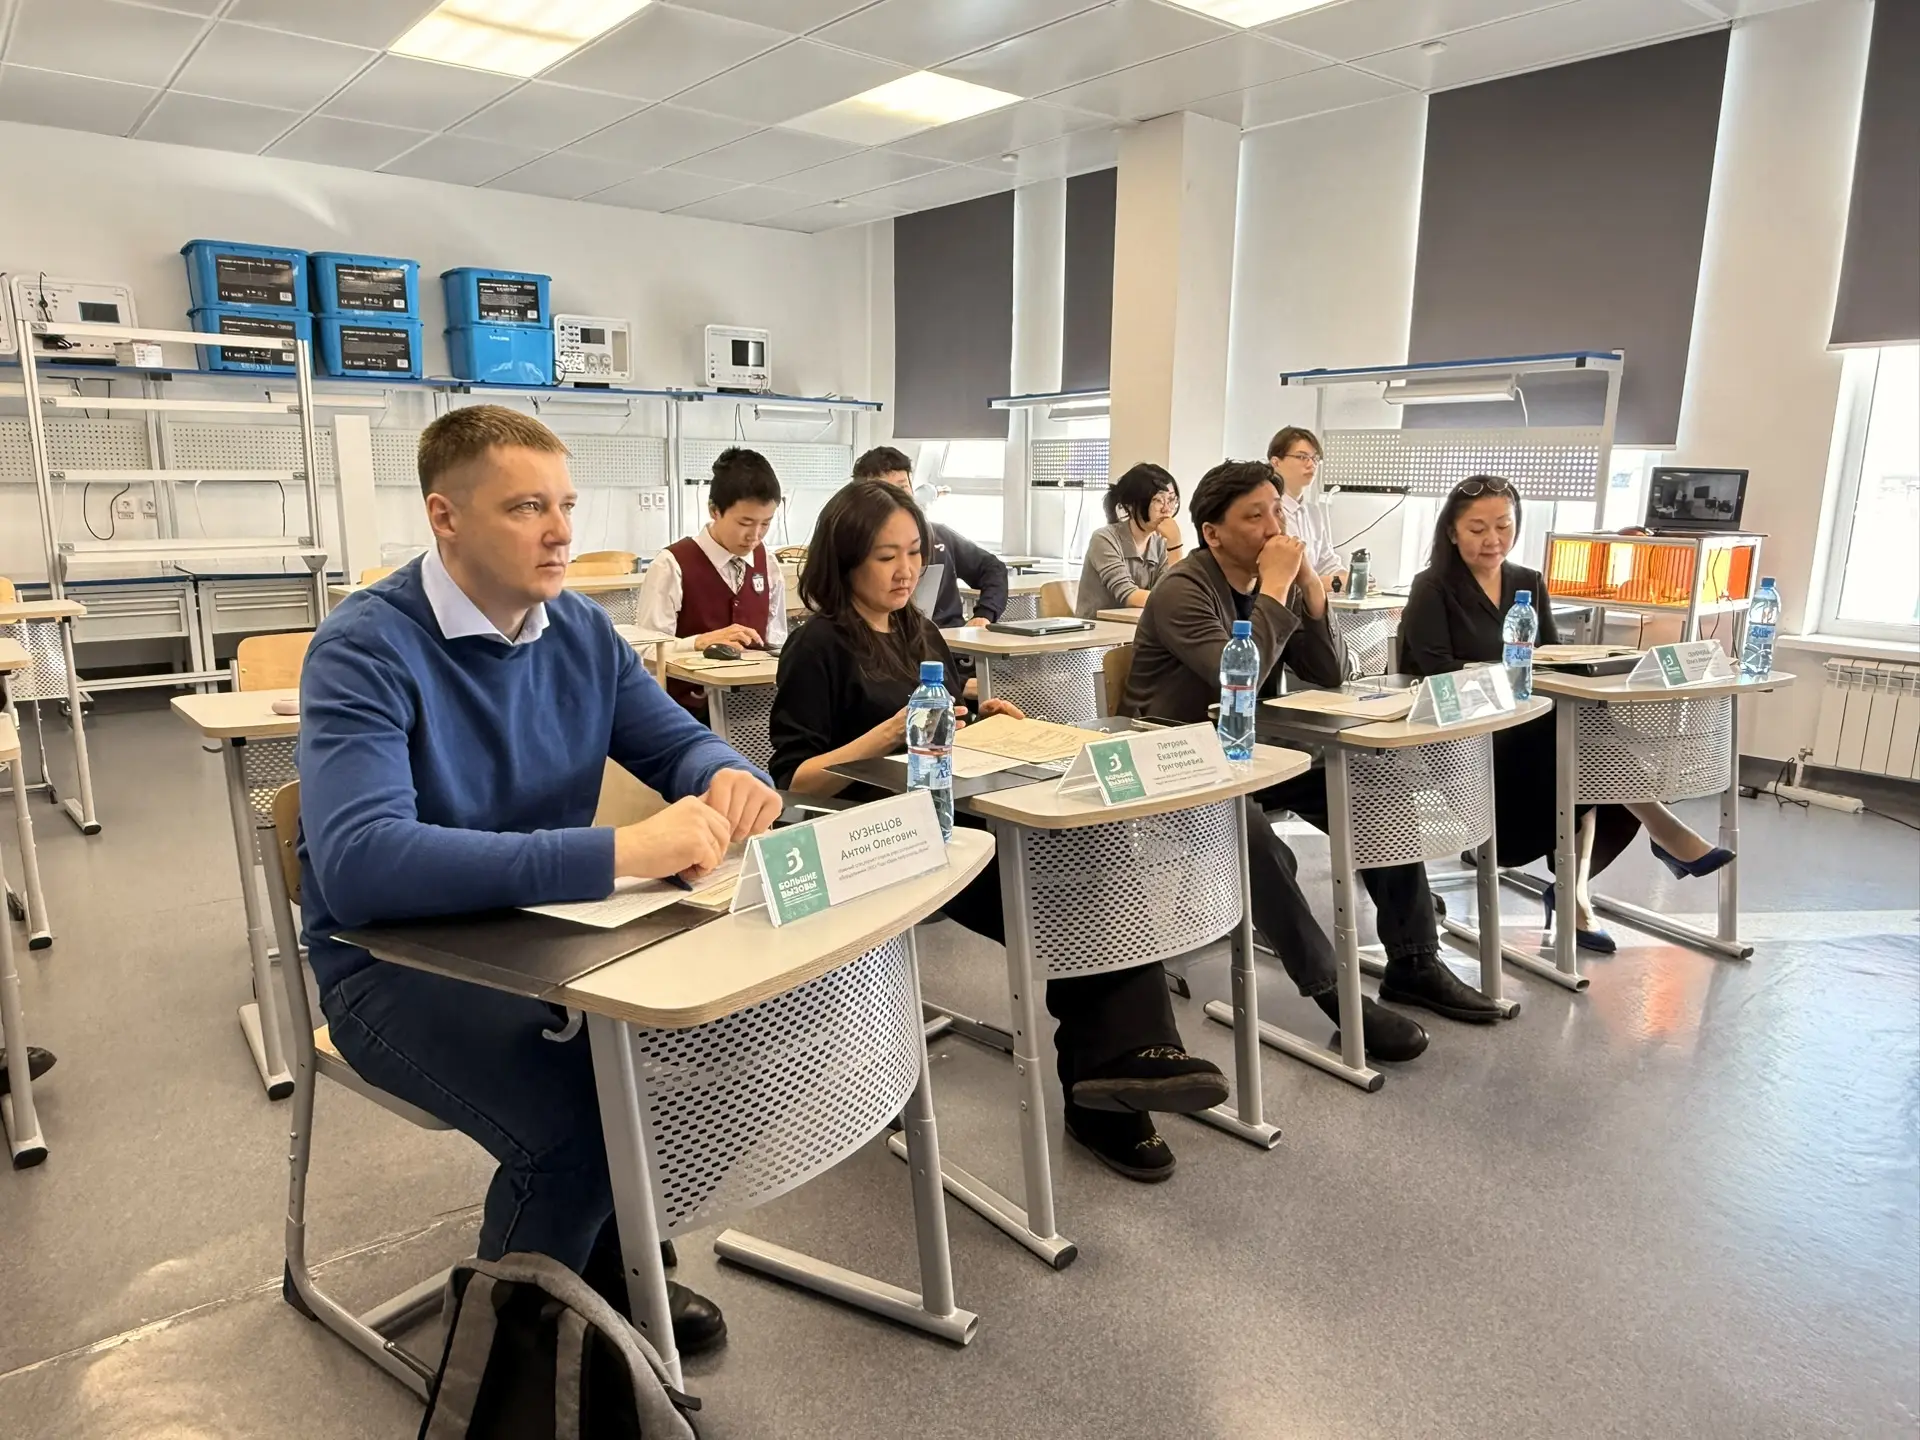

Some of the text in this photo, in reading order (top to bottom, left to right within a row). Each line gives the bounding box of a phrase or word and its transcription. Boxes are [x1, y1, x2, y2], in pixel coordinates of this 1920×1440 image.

[1157, 738, 1188, 751] Петрова
[1156, 748, 1196, 761] Екатерина
[1157, 757, 1204, 772] Григорьевна
[848, 816, 903, 842] КУЗНЕЦОВ
[840, 843, 872, 861] Антон
[873, 828, 919, 849] Олегович
[778, 871, 818, 890] БОЛЬШИЕ
[780, 880, 817, 899] ВЫЗОВЫ
